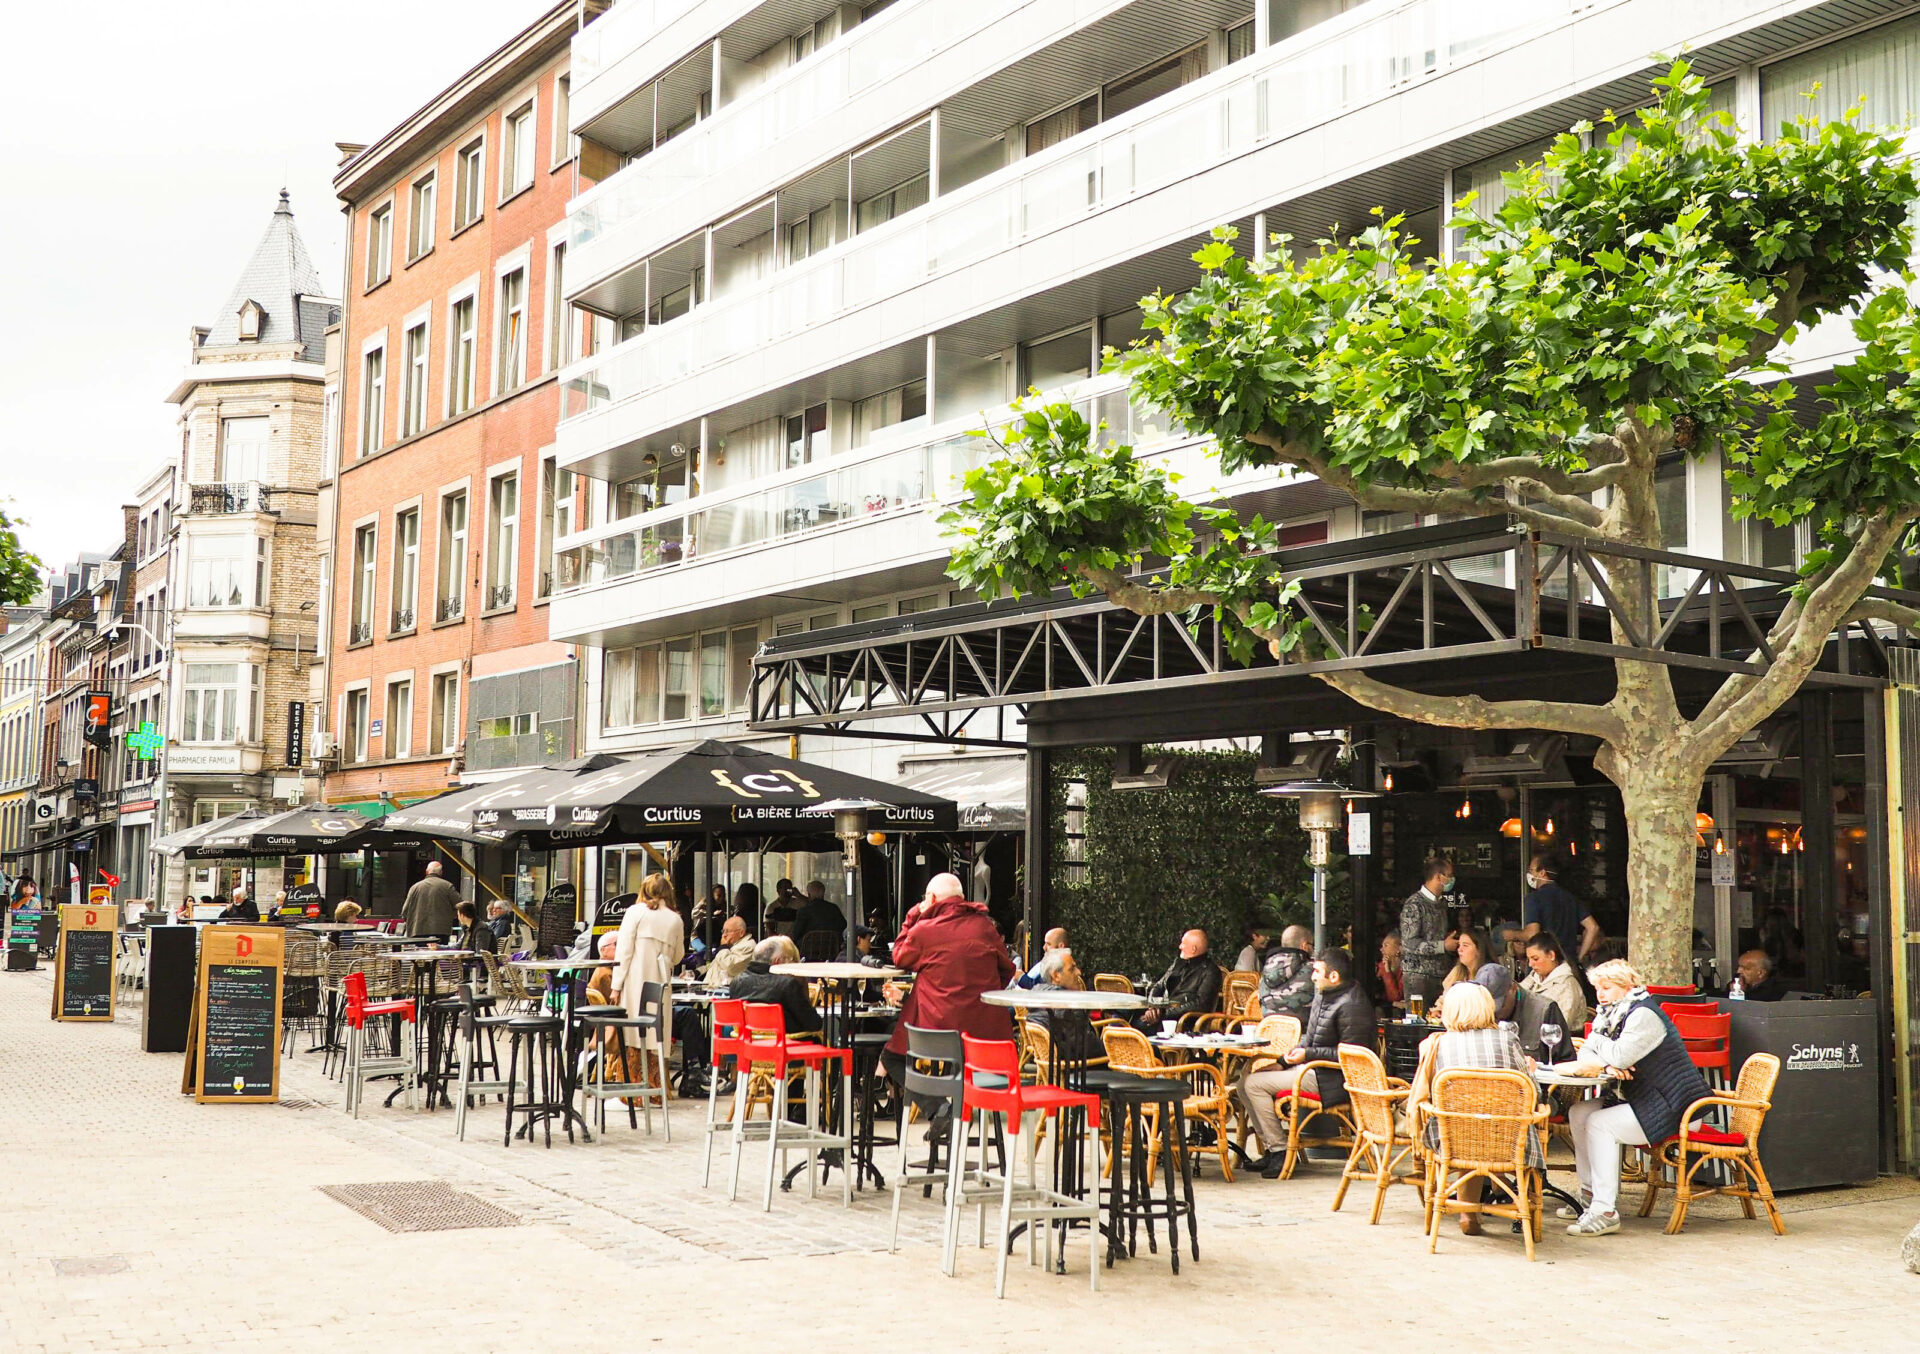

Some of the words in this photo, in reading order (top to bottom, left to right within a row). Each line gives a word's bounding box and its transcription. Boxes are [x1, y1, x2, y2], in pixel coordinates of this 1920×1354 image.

[291, 704, 300, 765] RESTAURANT
[169, 756, 207, 765] PHARMACIE
[208, 756, 235, 765] FAMILIA
[478, 811, 499, 824] Curtius
[516, 809, 547, 821] BRASSERIE
[572, 806, 599, 822] Curtius
[643, 807, 701, 822] Curtius
[738, 808, 754, 819] LA
[757, 805, 792, 819] BIÈRE
[885, 806, 935, 820] Curtius
[267, 836, 296, 844] Curtius
[196, 848, 224, 856] Curtius
[1787, 1043, 1843, 1062] Schyns
